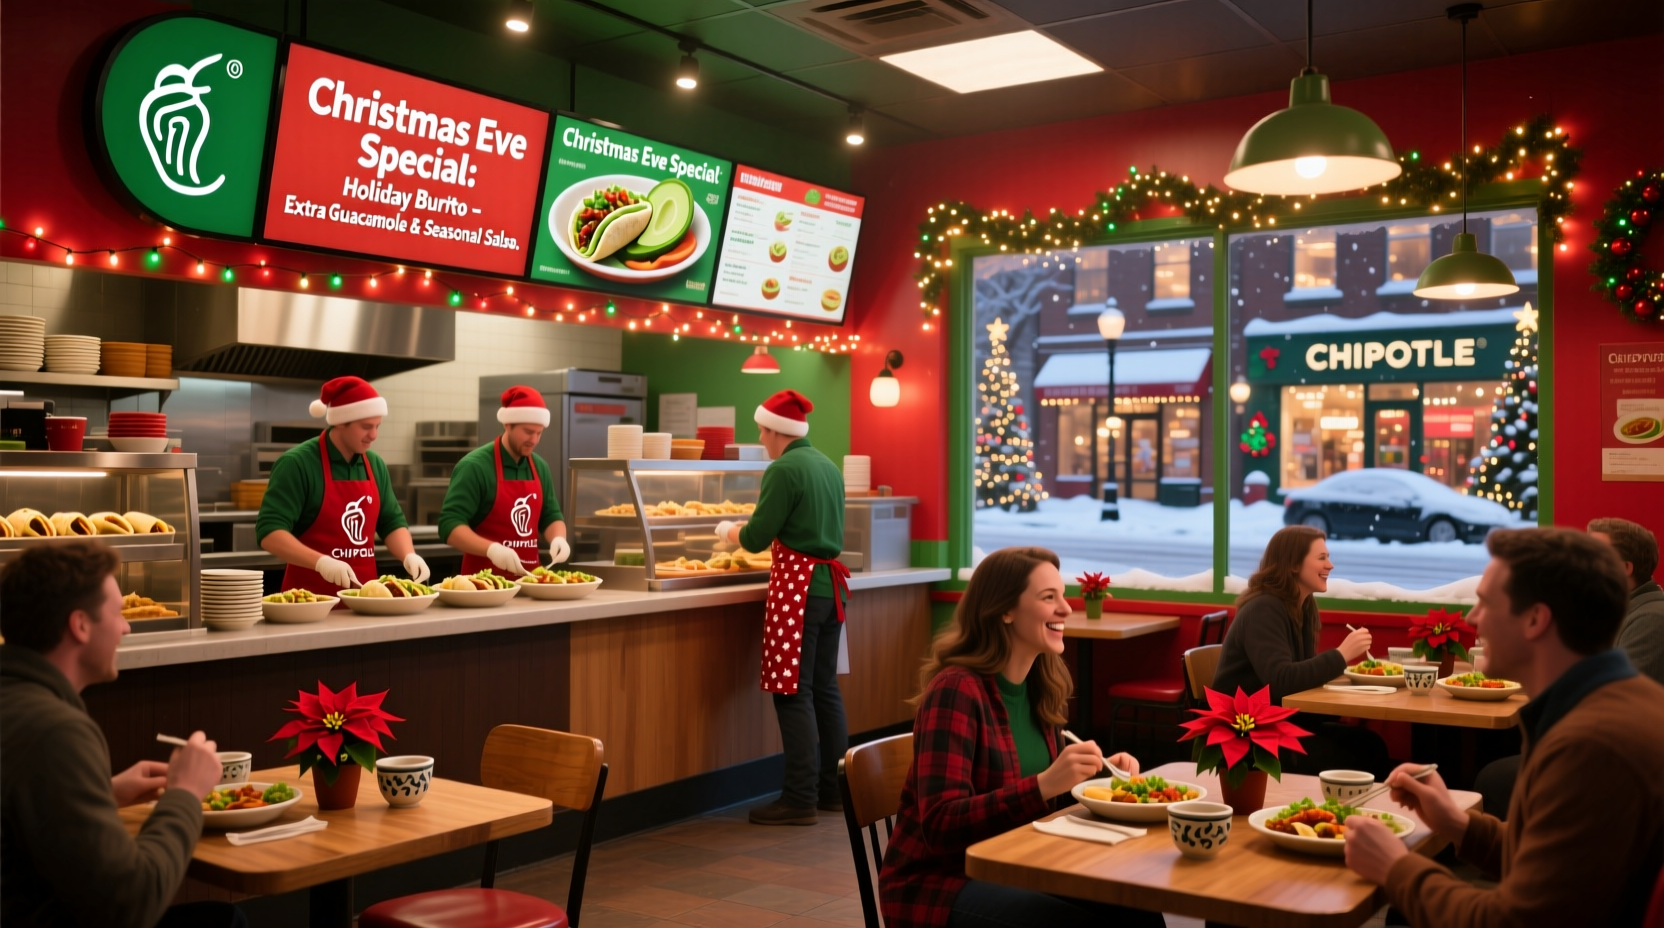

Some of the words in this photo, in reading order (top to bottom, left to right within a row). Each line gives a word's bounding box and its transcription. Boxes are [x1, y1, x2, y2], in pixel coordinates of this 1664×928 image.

[308, 77, 471, 147] Christmas
[475, 117, 528, 160] Eve
[357, 132, 478, 188] Special:
[562, 127, 640, 163] Christmas
[641, 146, 668, 171] Eve
[342, 176, 413, 212] Holiday
[284, 194, 327, 219] Extra
[409, 217, 421, 235] &
[422, 219, 483, 244] Seasonal
[1305, 338, 1476, 371] CHIPOTLE
